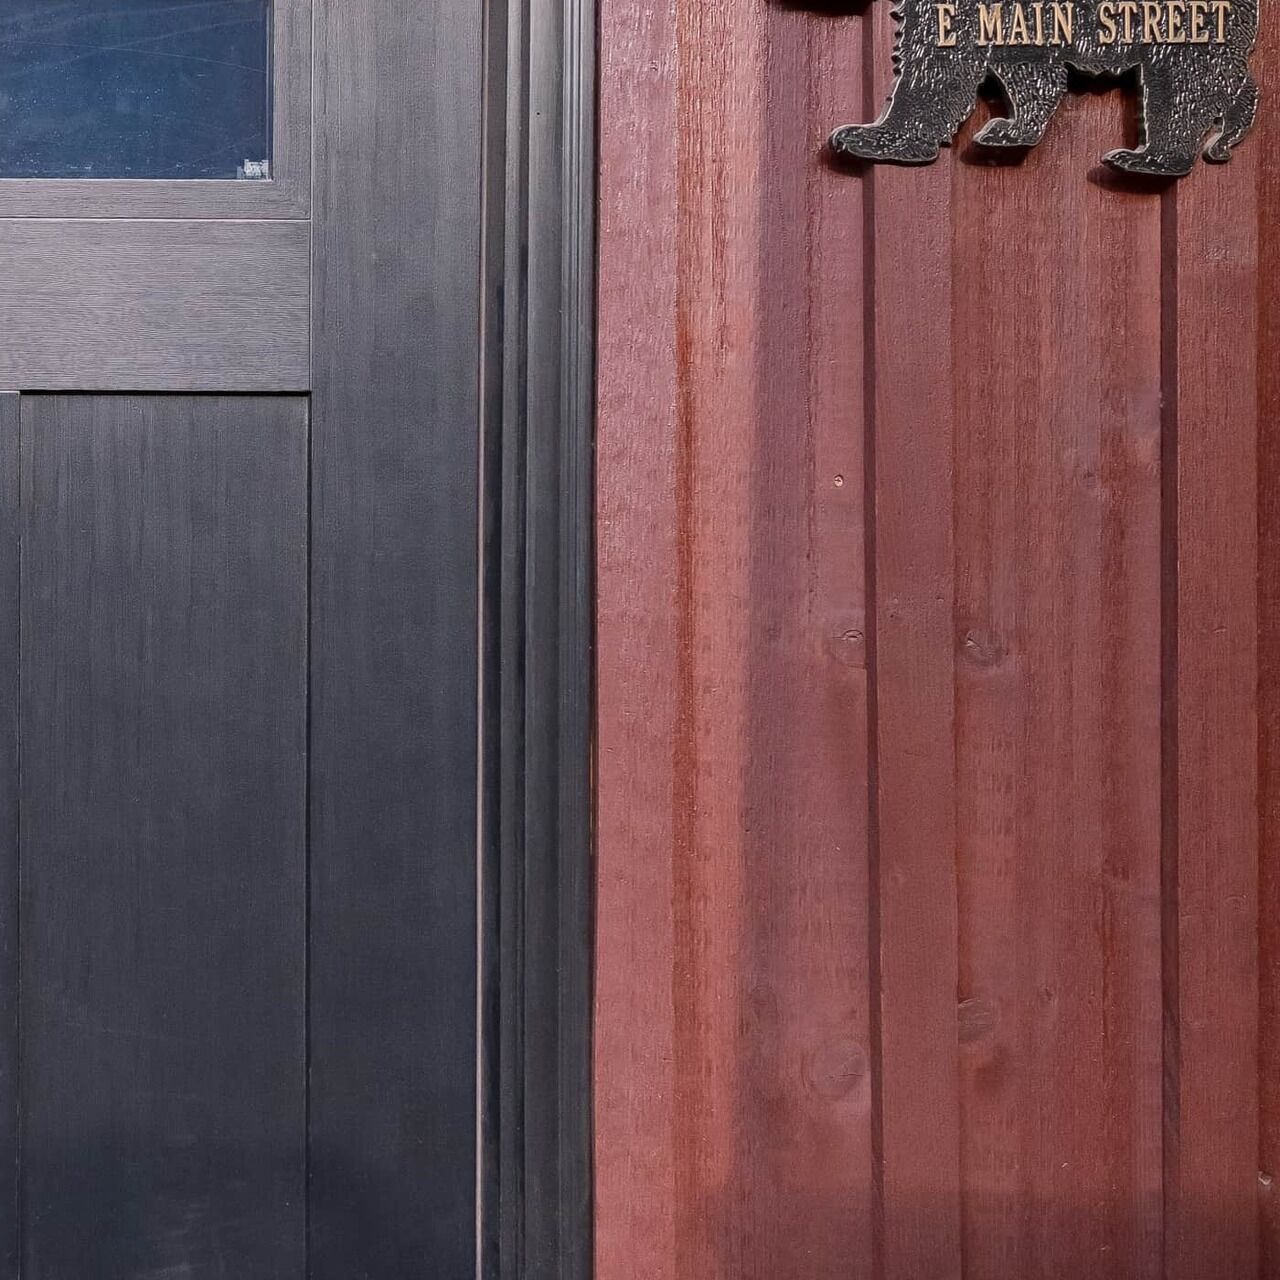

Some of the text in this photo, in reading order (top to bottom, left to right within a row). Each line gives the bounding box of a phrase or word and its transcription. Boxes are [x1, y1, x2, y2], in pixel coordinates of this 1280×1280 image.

[936, 0, 1232, 48] E MAIN STREET
